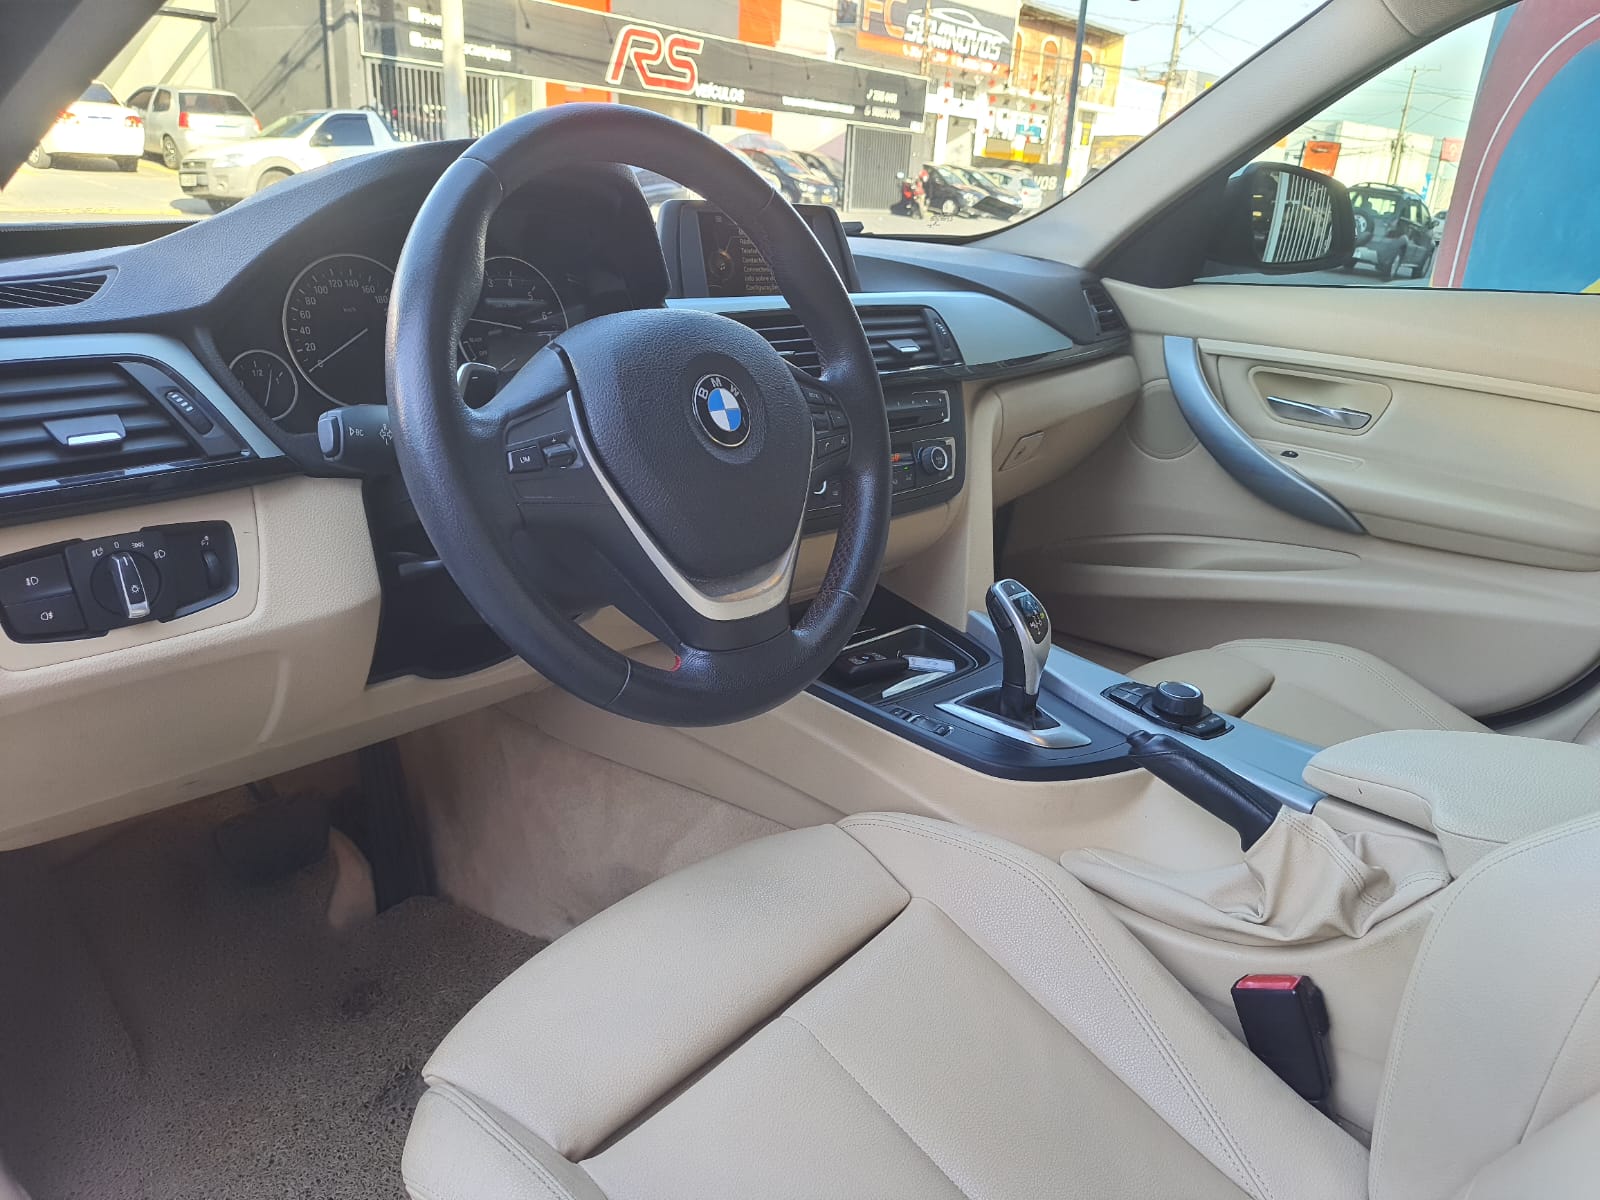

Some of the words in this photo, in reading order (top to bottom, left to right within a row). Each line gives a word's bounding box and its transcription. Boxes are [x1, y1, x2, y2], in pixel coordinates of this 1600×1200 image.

[605, 24, 704, 96] RS
[328, 279, 343, 288] 120
[344, 279, 359, 288] 140
[313, 286, 329, 295] 100
[361, 285, 376, 294] 160
[305, 296, 317, 305] 80
[374, 295, 389, 304] 180
[527, 291, 534, 301] 5
[300, 310, 311, 320] 60
[541, 311, 548, 320] 6
[300, 326, 311, 335] 40
[304, 342, 316, 352] 20
[698, 376, 740, 400] BMW
